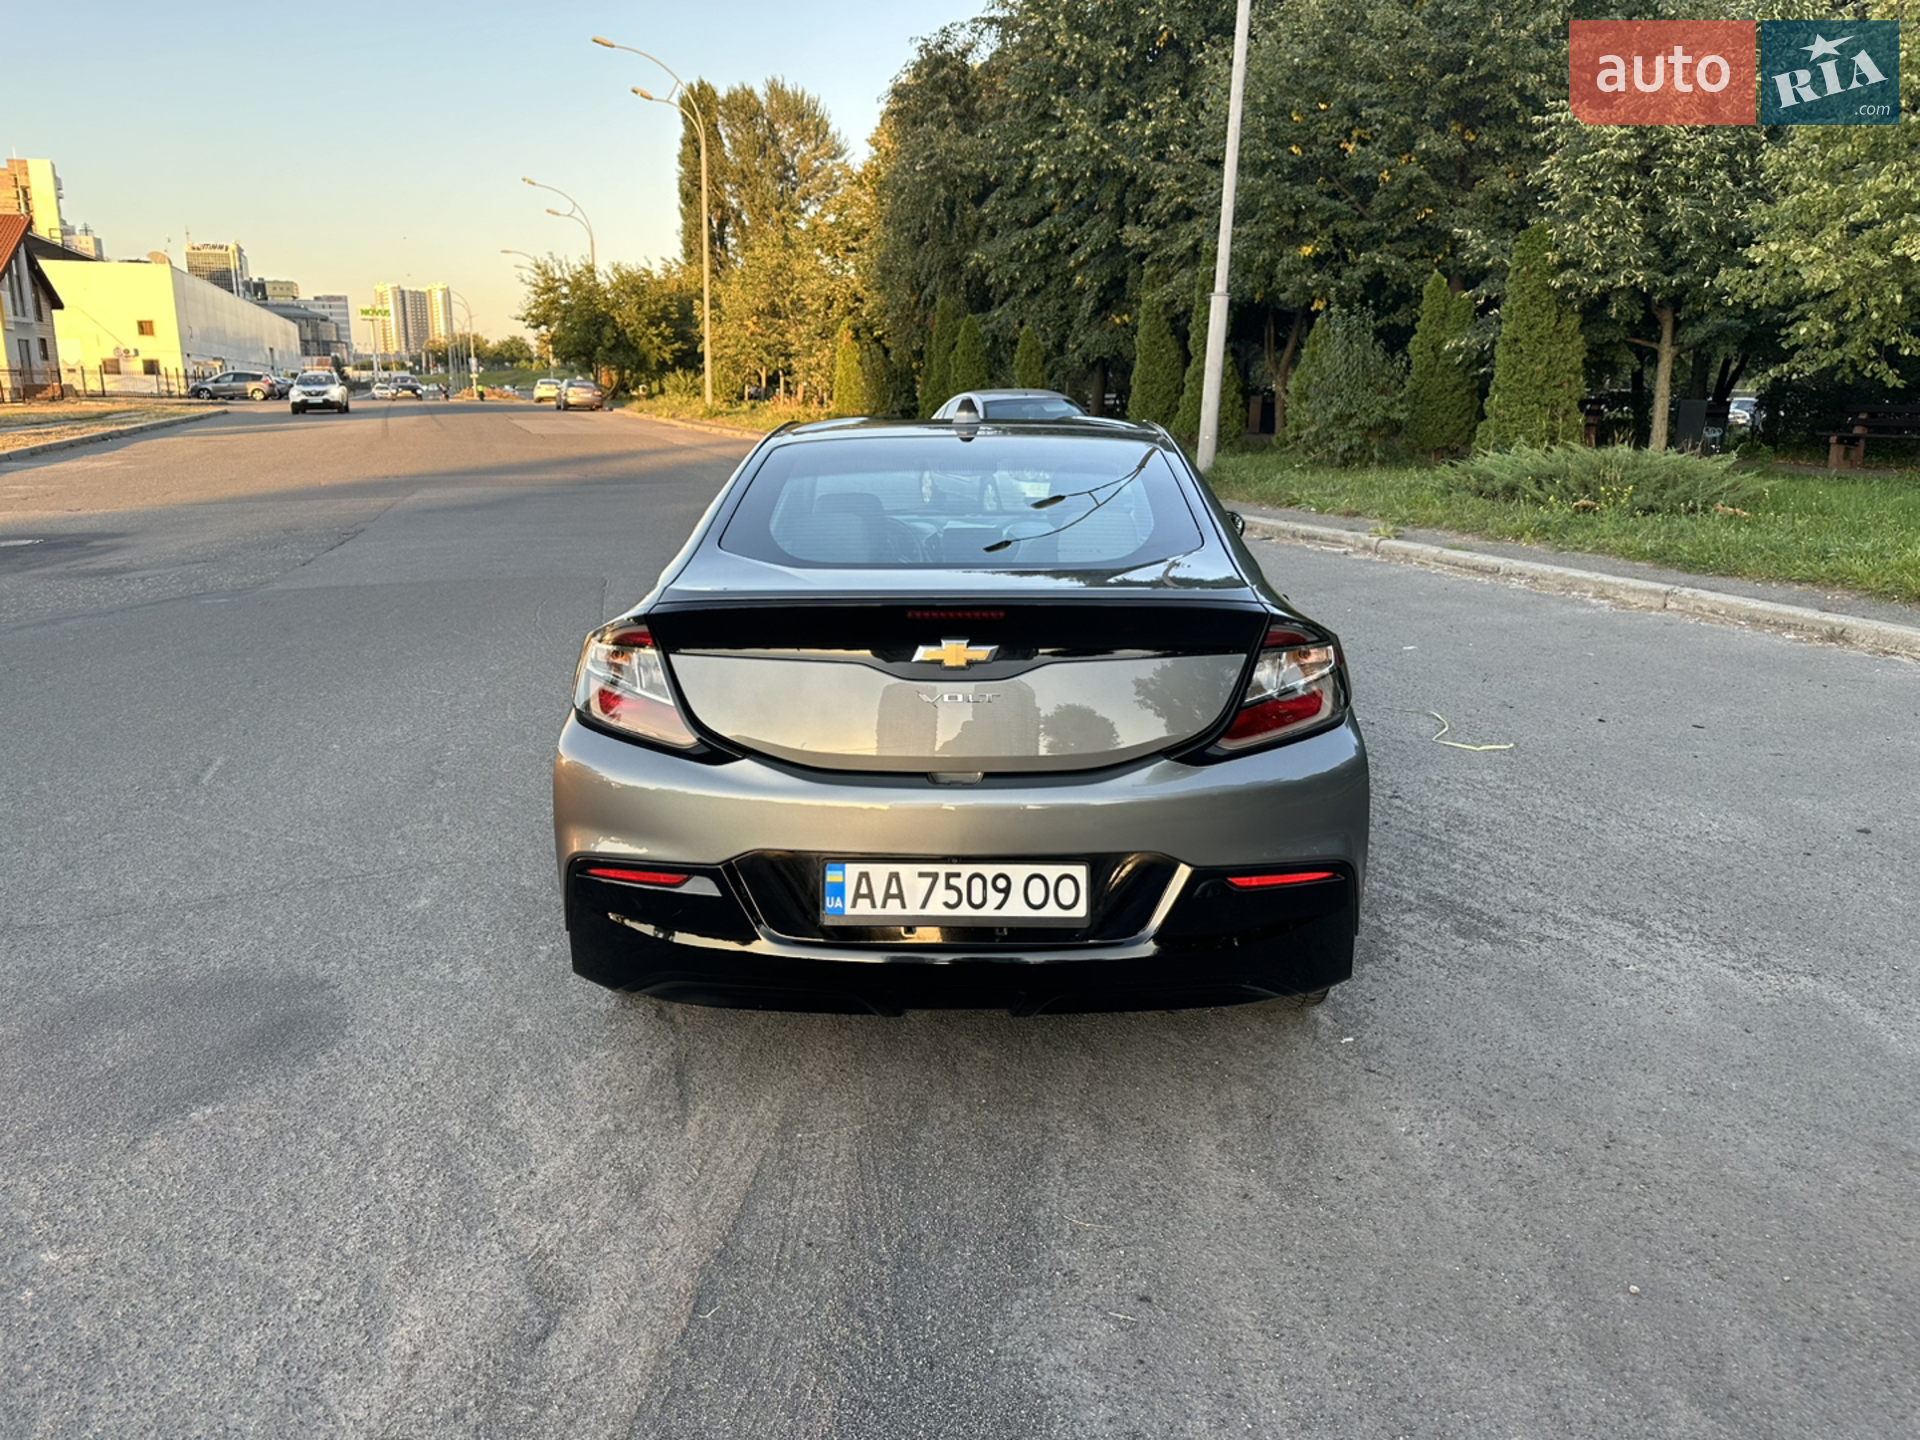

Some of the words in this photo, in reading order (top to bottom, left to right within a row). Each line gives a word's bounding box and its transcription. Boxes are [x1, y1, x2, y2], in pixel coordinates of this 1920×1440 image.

[360, 308, 391, 317] NOVUS
[916, 690, 1001, 708] VOLT
[850, 871, 908, 910] AA
[917, 871, 1013, 911] 7509
[1023, 872, 1081, 911] OO
[826, 897, 844, 909] UA
